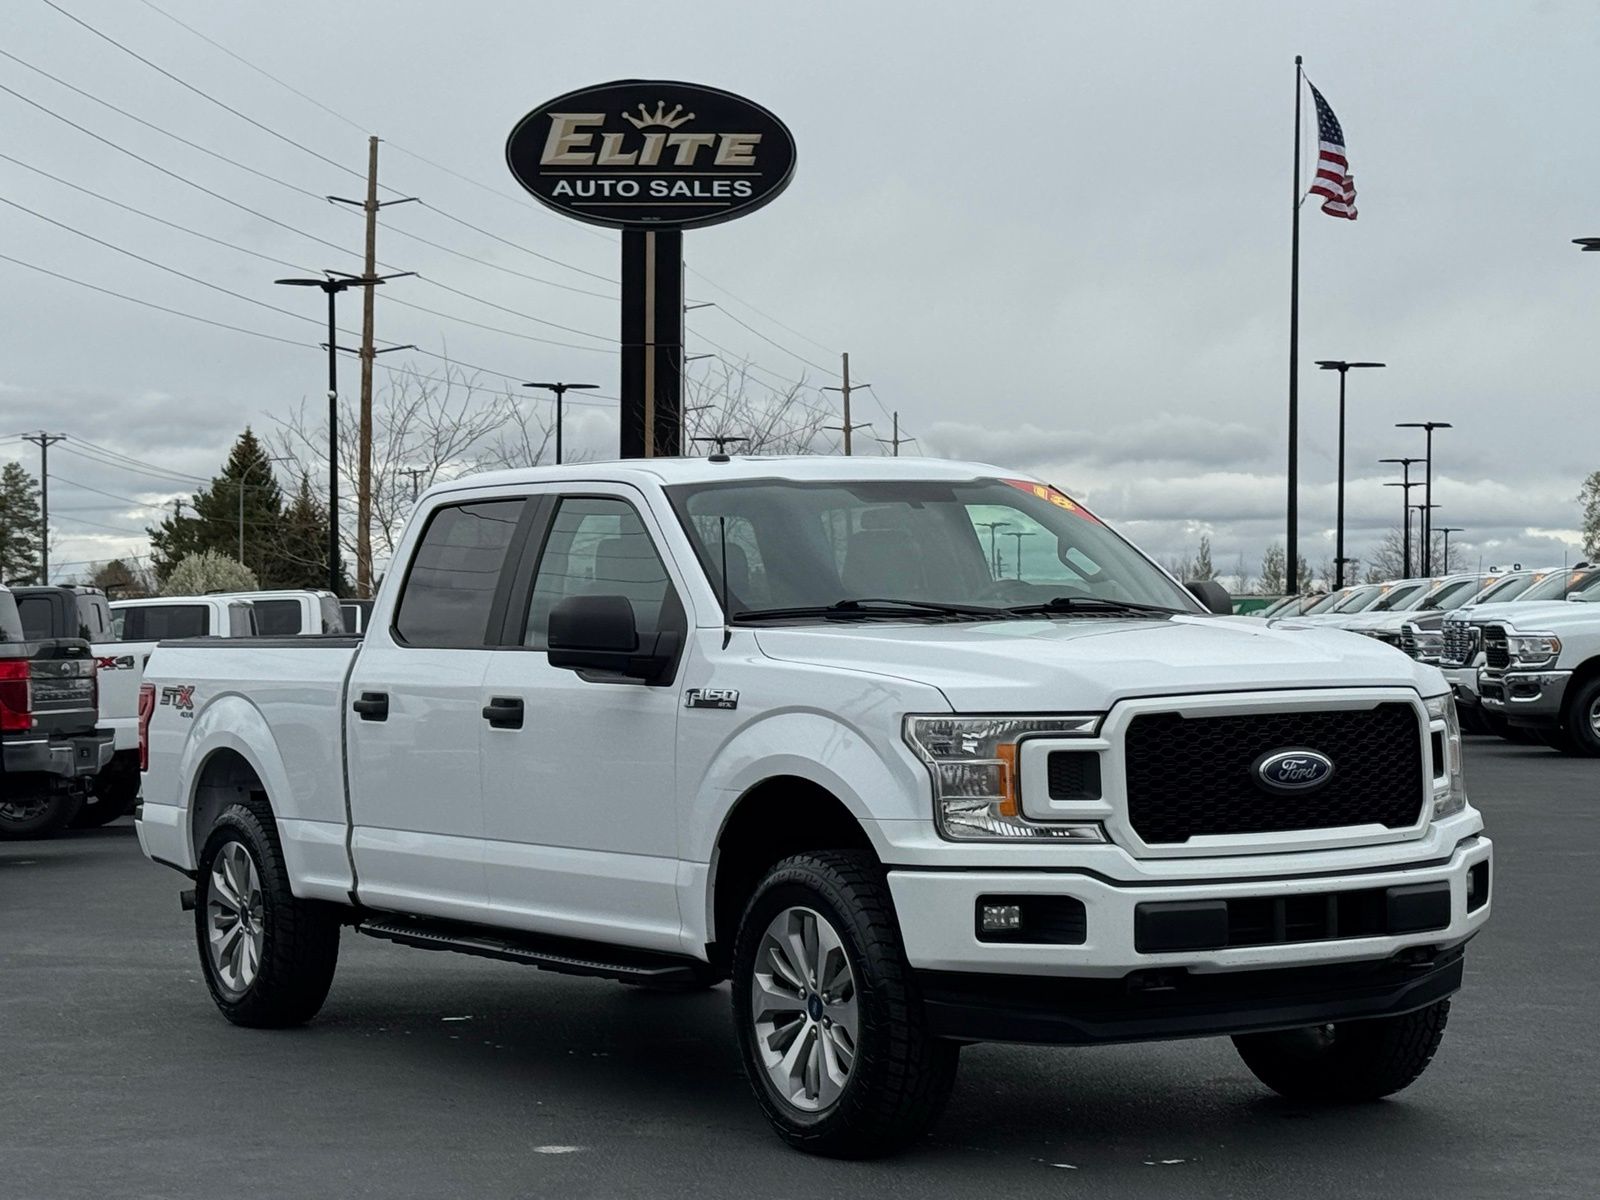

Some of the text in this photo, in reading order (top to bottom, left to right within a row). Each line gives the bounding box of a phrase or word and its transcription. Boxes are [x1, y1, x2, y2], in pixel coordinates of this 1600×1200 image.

[540, 113, 763, 166] ELITE
[551, 180, 752, 197] AUTO SALES
[160, 685, 195, 710] STX
[1278, 759, 1317, 780] Ford
